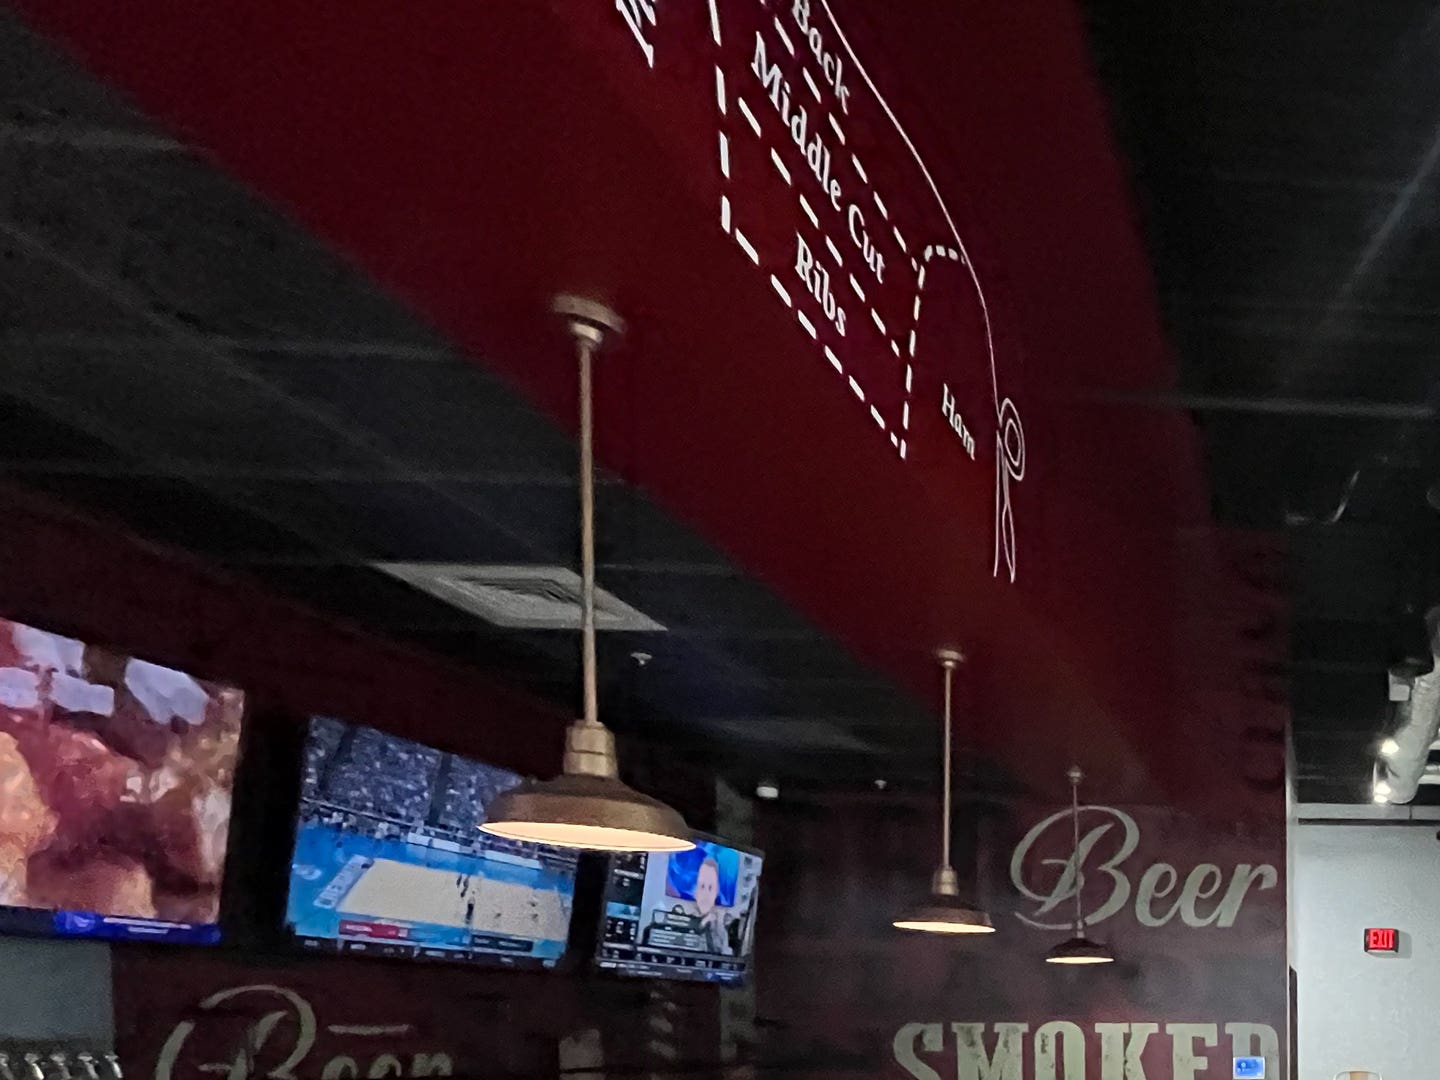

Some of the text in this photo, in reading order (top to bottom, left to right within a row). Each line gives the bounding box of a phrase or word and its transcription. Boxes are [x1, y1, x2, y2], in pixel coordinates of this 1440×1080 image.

[751, 31, 884, 284] Middle Cut
[794, 231, 847, 337] Ribs
[941, 383, 976, 461] Ham
[1010, 804, 1279, 931] Beer
[1368, 928, 1395, 949] EXIT
